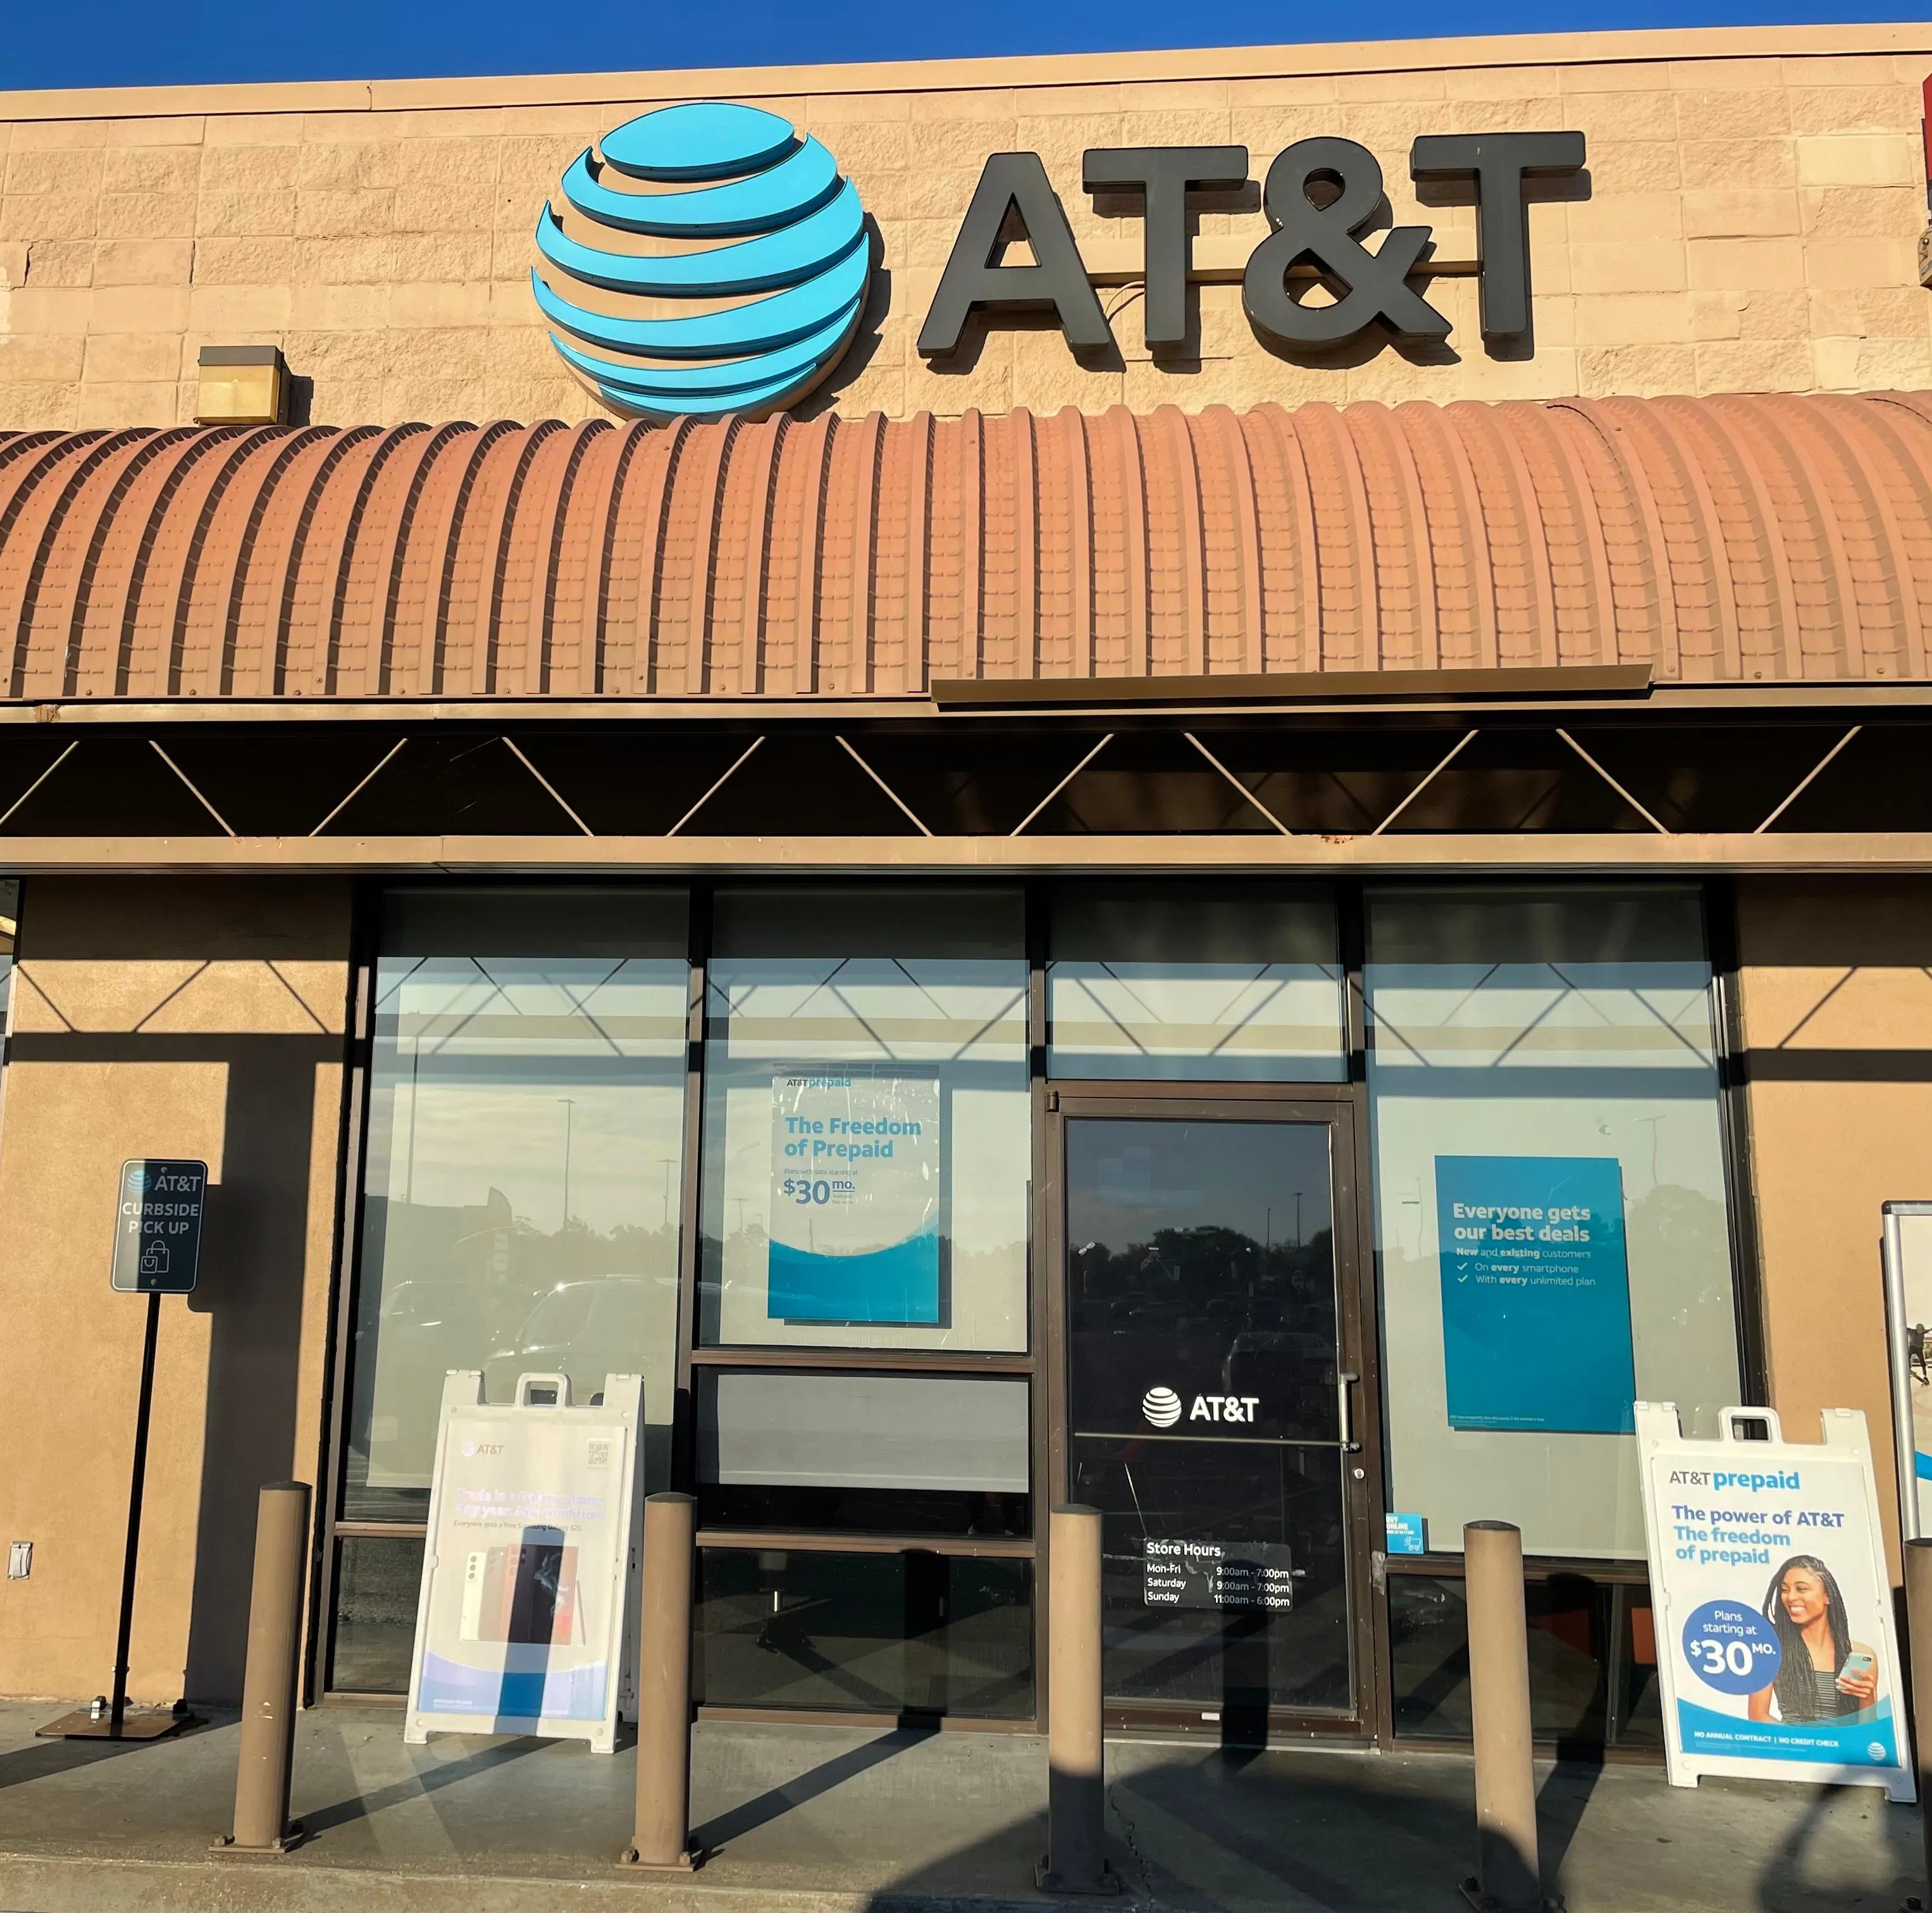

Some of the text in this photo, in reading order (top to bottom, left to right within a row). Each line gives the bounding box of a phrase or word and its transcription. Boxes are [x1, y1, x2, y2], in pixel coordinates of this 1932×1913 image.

[917, 131, 1585, 356] AT&T
[787, 1078, 851, 1089] AT&T prepaid
[785, 1117, 921, 1136] The Freedom
[784, 1139, 893, 1161] of Prepaid
[154, 1175, 201, 1192] AT&T
[784, 1178, 855, 1204] $30 mo.
[122, 1202, 199, 1217] CURBSIDE
[1453, 1203, 1591, 1225] Everyone gets
[128, 1221, 189, 1234] PICK UP
[1454, 1224, 1590, 1242] our best deals
[1456, 1247, 1591, 1259] New and existing customers
[1475, 1263, 1579, 1274] On every smartphone
[1476, 1275, 1595, 1287] With every unlimited plan
[1189, 1396, 1260, 1422] AT&T
[476, 1444, 504, 1455] AT&T
[1669, 1471, 1800, 1492] AT&T prepaid
[1672, 1505, 1844, 1527] The power of AT&T
[1674, 1526, 1790, 1546] The freedom
[1146, 1542, 1221, 1557] Store Hours
[1676, 1545, 1770, 1566] of prepaid
[1147, 1564, 1181, 1574] Mon-Fri
[1216, 1566, 1249, 1576] 9:00am
[1256, 1568, 1289, 1579] 7:00pm
[1147, 1577, 1186, 1590] Saturday
[1216, 1581, 1249, 1591] 9:00am
[1257, 1583, 1289, 1594] 7:00pm
[1148, 1591, 1180, 1603] Sunday
[1213, 1594, 1249, 1604] 11:00am
[1256, 1597, 1290, 1608] 6:00pm
[1714, 1610, 1742, 1622] Plans
[1703, 1623, 1757, 1637] starting at
[1690, 1639, 1776, 1676] $30 MO.
[1735, 1734, 1771, 1743] CONTRACT
